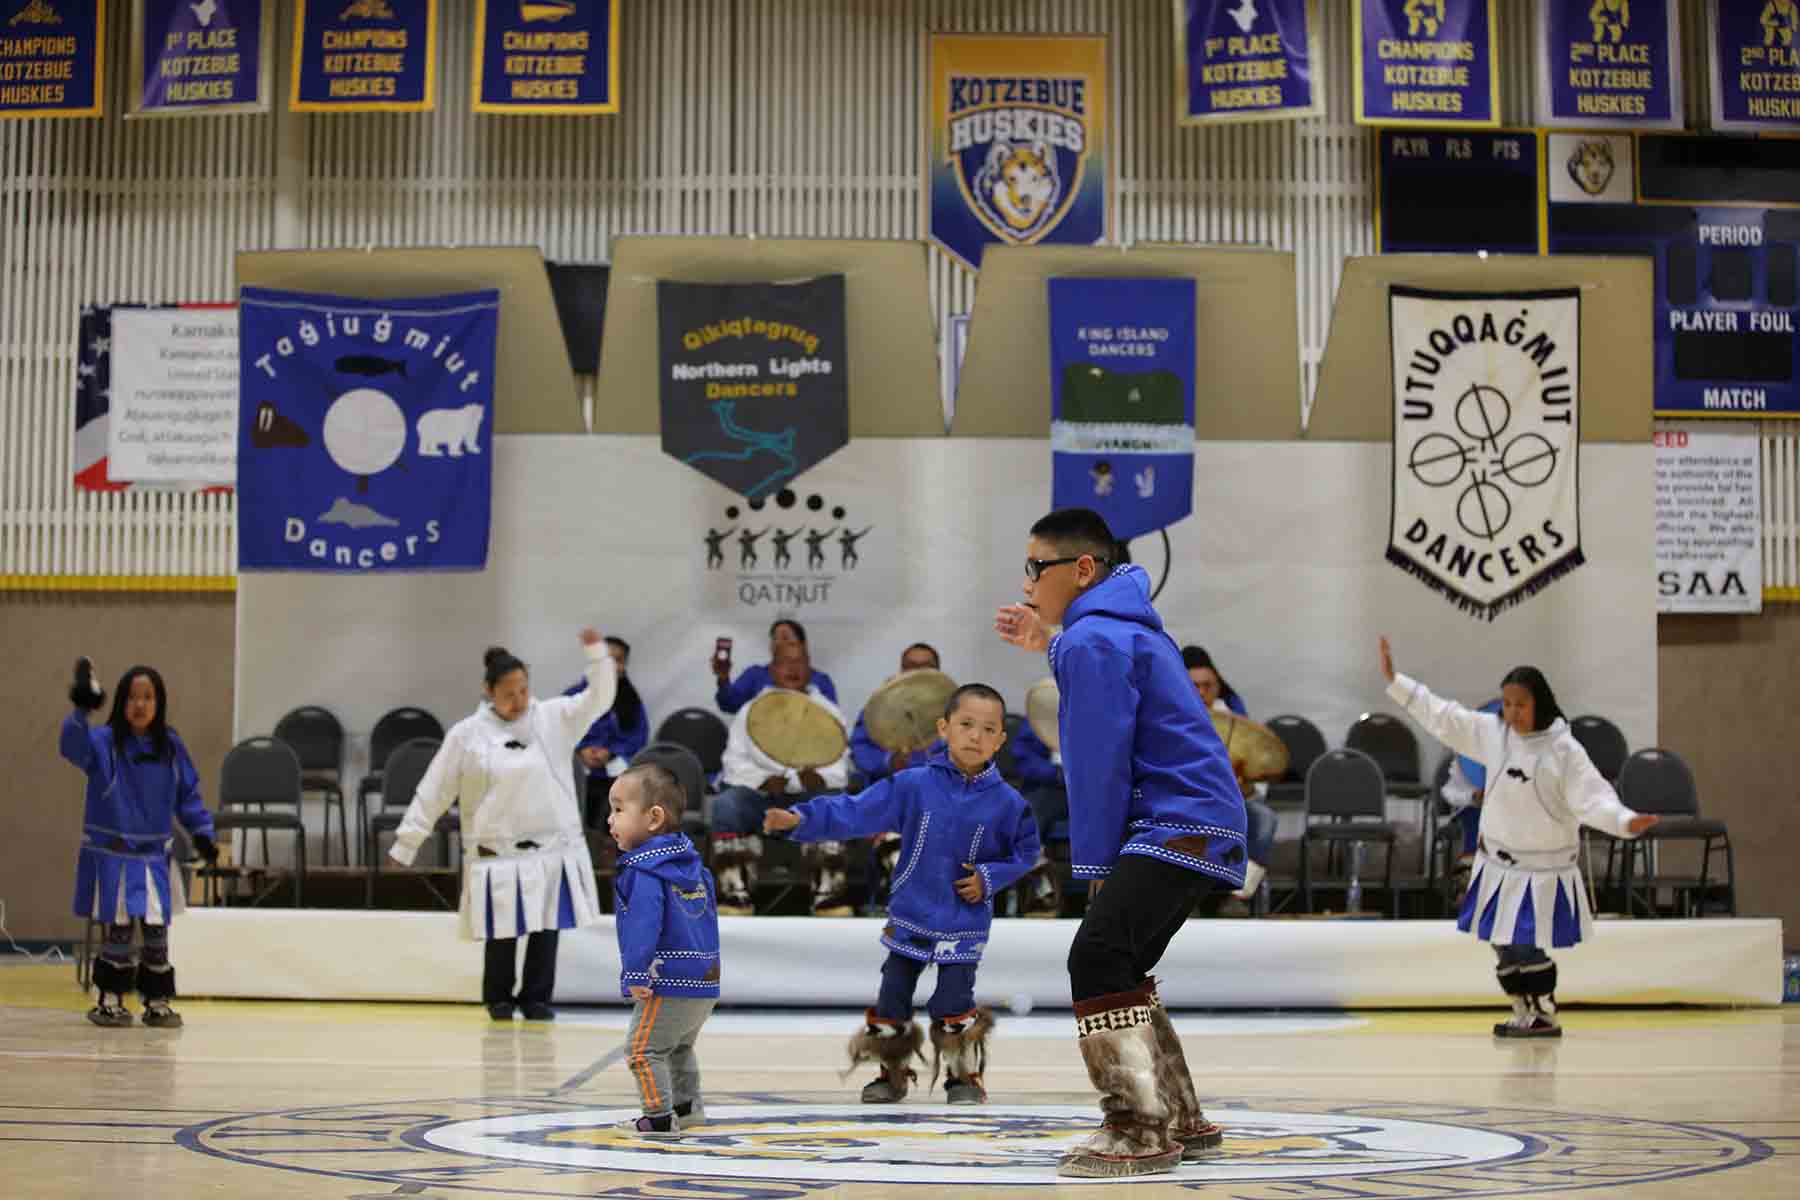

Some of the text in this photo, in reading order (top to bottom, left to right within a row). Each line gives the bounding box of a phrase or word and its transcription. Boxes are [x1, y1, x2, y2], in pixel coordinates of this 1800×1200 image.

[187, 29, 237, 49] PLACE
[322, 30, 408, 49] CHAMPIONS
[503, 31, 589, 49] CHAMPIONS
[1228, 34, 1281, 55] PLACE
[1378, 39, 1475, 61] CHAMPIONS
[1599, 44, 1649, 64] PLACE
[161, 54, 240, 77] KOTZEBUE
[323, 54, 404, 73] KOTZEBUE
[504, 55, 585, 74] KOTZEBUE
[1202, 59, 1288, 84] KOTZEBUE
[1384, 65, 1469, 86] KOTZEBUE
[1569, 69, 1653, 89] KOTZEBUE
[0, 84, 65, 104] HUSKIES
[166, 80, 234, 101] HUSKIES
[329, 77, 396, 96] HUSKIES
[511, 79, 578, 98] HUSKIES
[951, 77, 1084, 115] KOTZEBUE
[1211, 86, 1282, 108] HUSKIES
[1392, 92, 1462, 112] HUSKIES
[1577, 93, 1646, 114] HUSKIES
[951, 107, 1084, 152] HUSKIES
[1446, 138, 1472, 158] FLS
[1493, 139, 1520, 159] PTS
[1699, 225, 1763, 244] PERIOD
[1670, 311, 1794, 331] PLAYER FOUL
[1078, 326, 1169, 341] KING ISLAND
[1088, 343, 1156, 357] DANCERS
[672, 356, 832, 381] Northern Lights
[706, 383, 798, 399] Dancers
[1704, 389, 1766, 409] MATCH
[285, 517, 440, 567] Dancers
[1405, 518, 1564, 583] DANCERS
